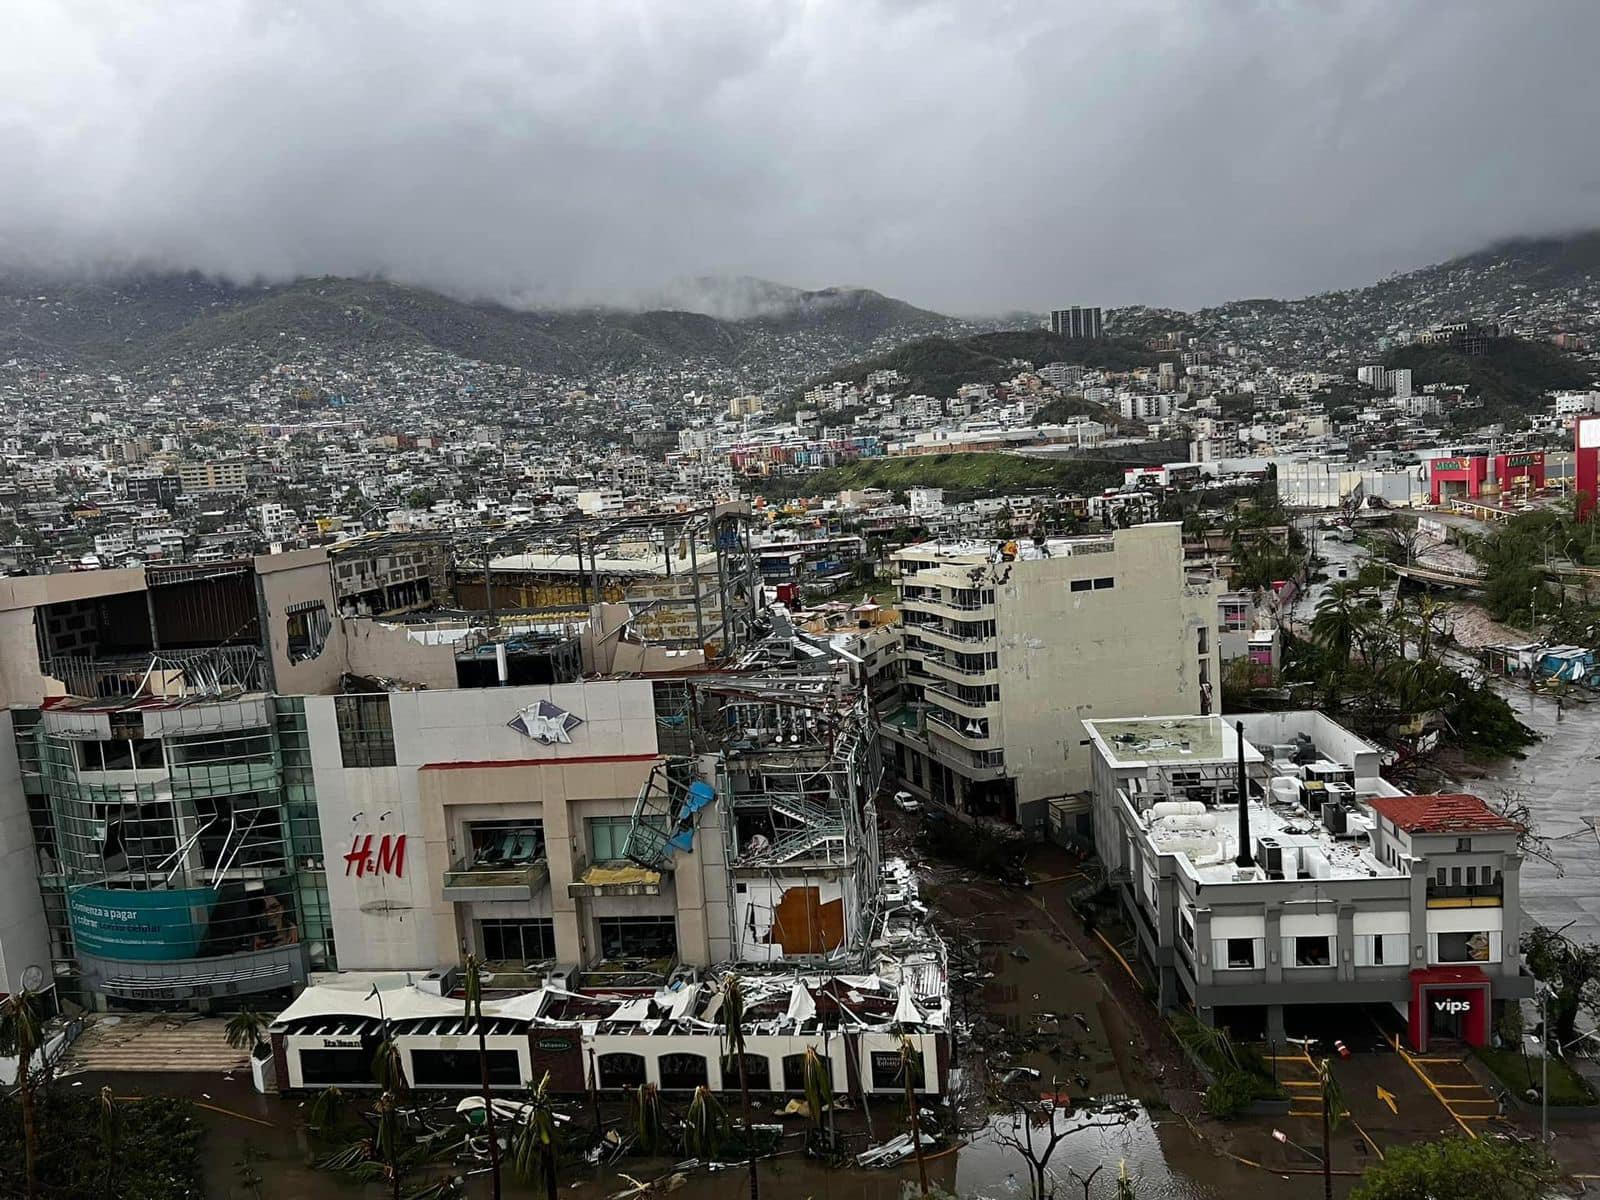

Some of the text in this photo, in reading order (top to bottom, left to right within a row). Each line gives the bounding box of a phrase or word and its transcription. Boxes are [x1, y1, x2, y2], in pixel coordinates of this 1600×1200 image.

[343, 834, 406, 879] H&M
[103, 908, 109, 918] a
[109, 909, 137, 922] pagar
[1434, 998, 1471, 1015] vips
